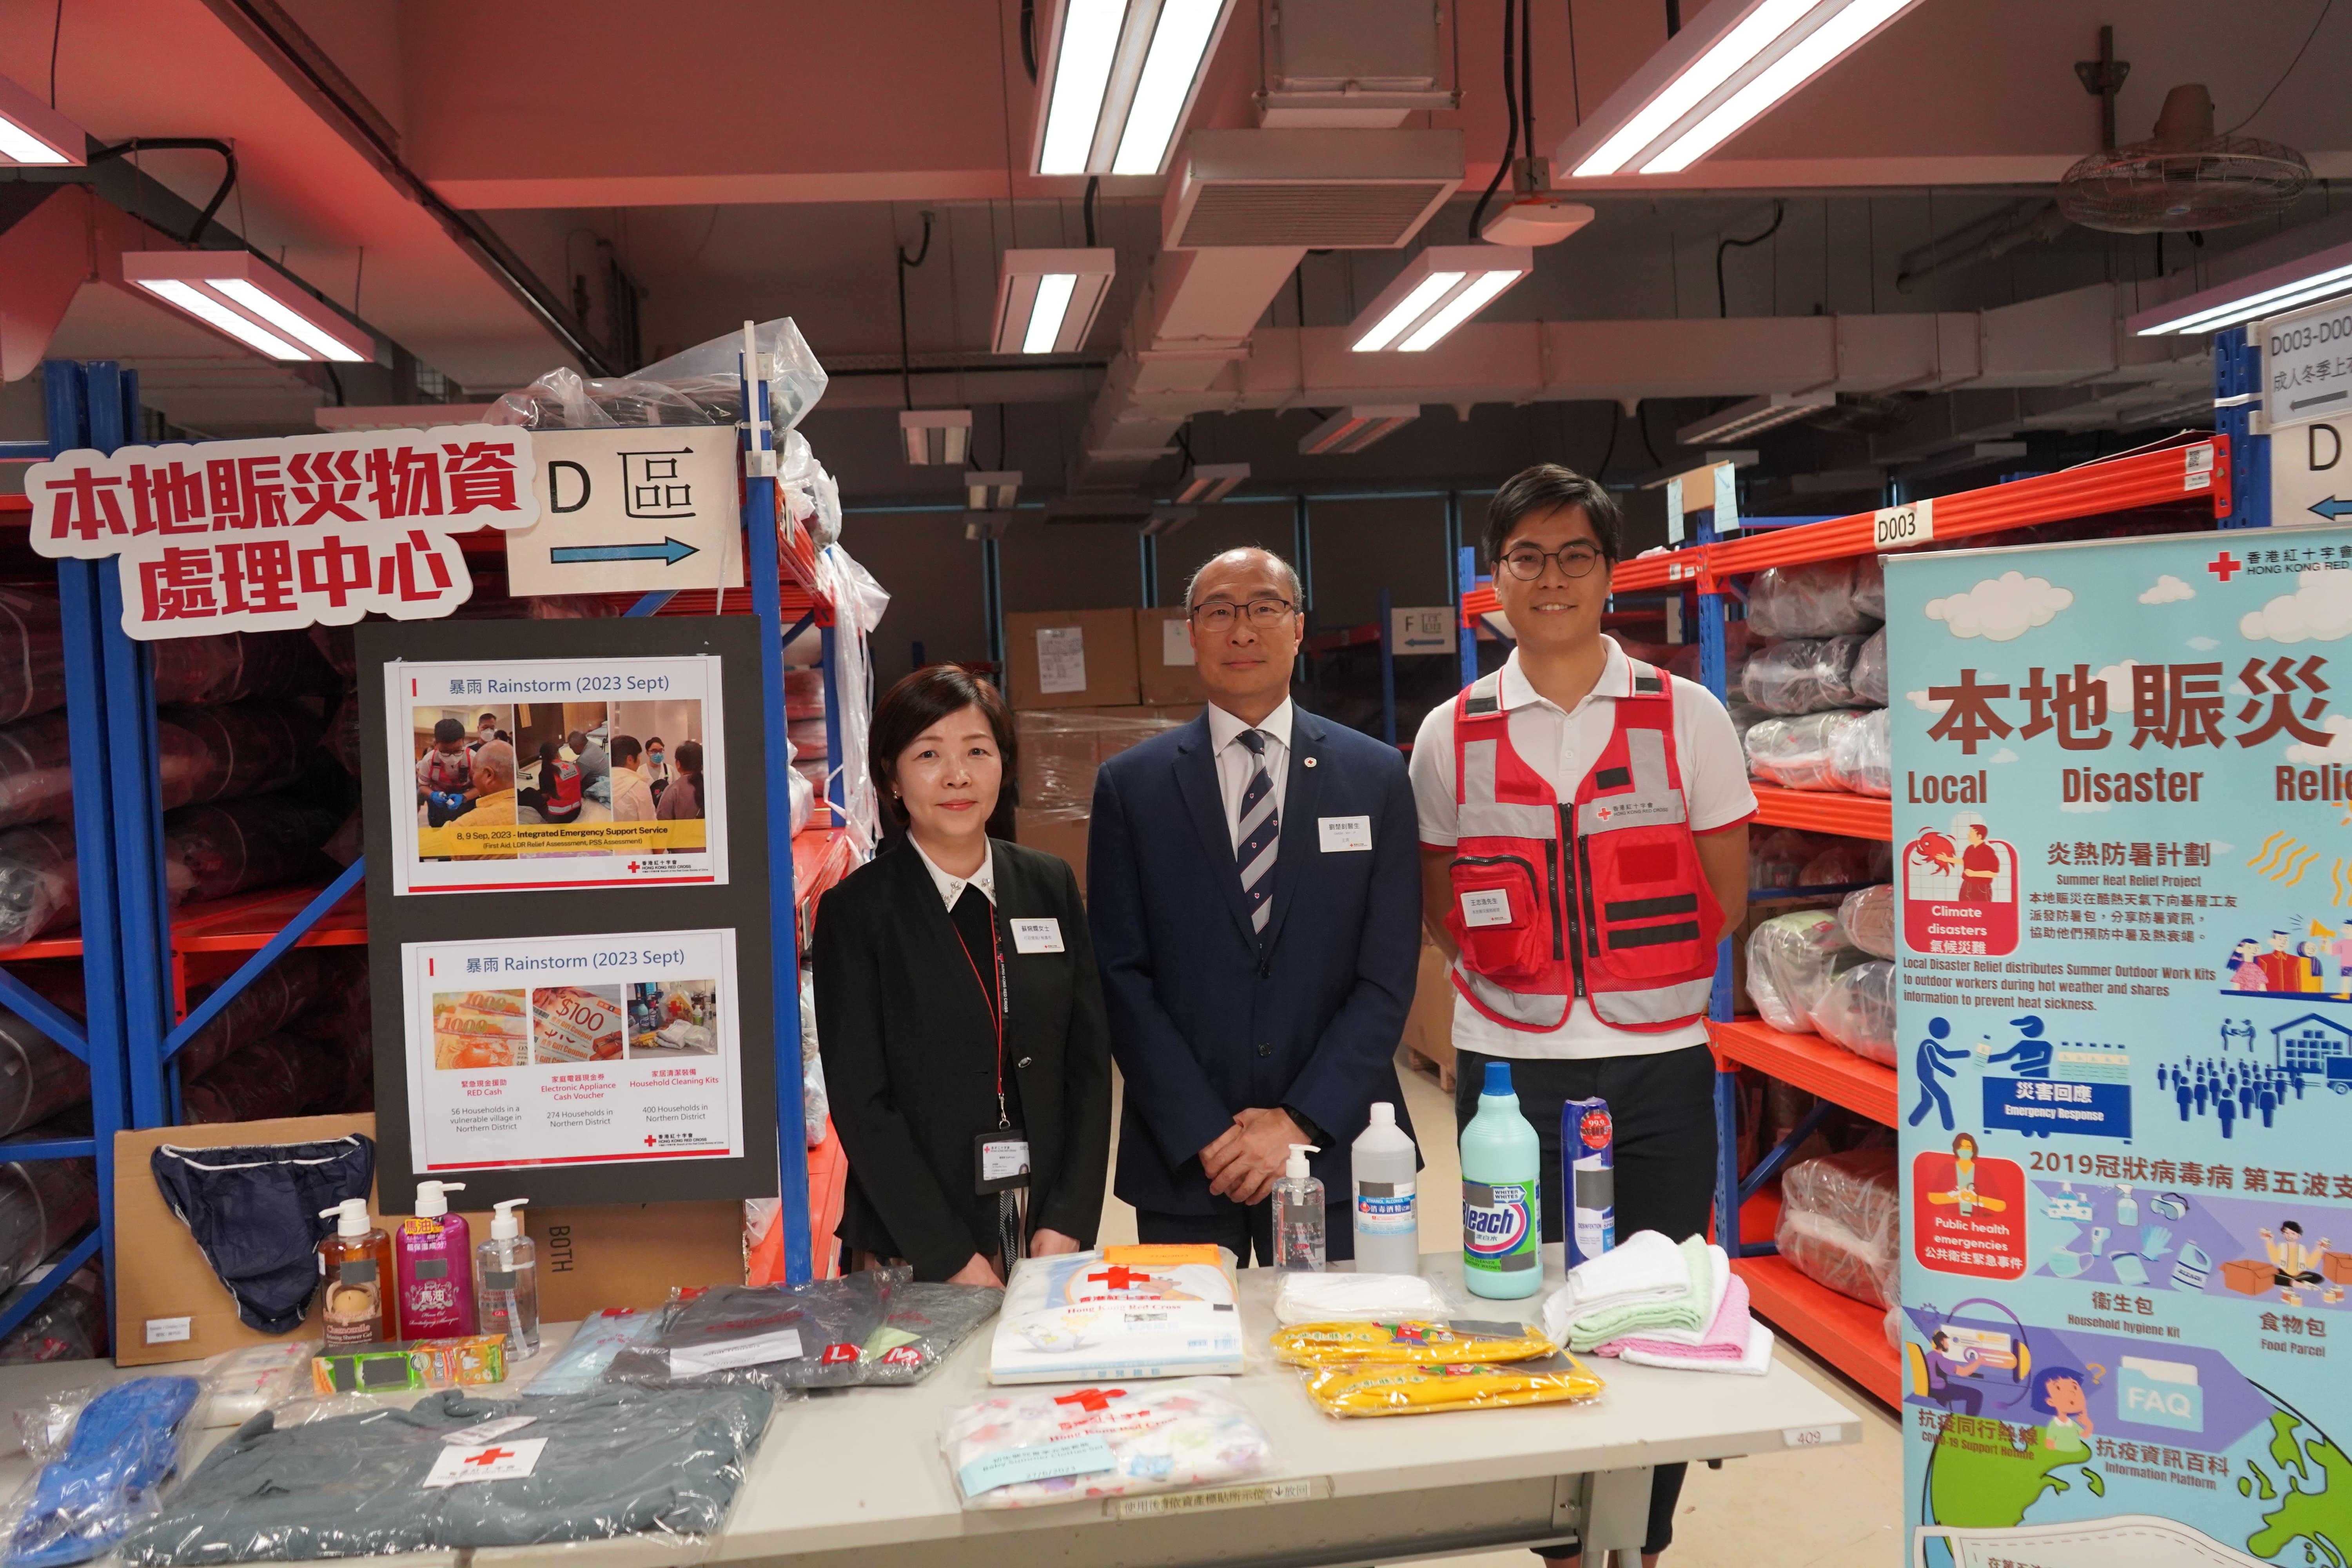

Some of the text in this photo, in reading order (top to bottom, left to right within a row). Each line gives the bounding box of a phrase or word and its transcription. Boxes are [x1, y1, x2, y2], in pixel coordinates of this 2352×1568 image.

[2309, 424, 2342, 471] D
[45, 441, 522, 541] 本地賑災物資
[548, 446, 697, 520] D 區
[1878, 512, 1916, 542] D003
[2247, 545, 2352, 564] 香港紅十字會
[140, 530, 453, 622] 處理中心
[2247, 561, 2350, 575] HONG KONG RED
[1406, 612, 1442, 634] F 區
[450, 675, 670, 694] 暴雨 Rainstorm (2023 Sept)
[1927, 655, 2336, 755] 本地賑災
[1908, 769, 1987, 804] Local
[2063, 766, 2205, 803] Disaster
[1613, 802, 1653, 811] 香港紅十字會
[517, 830, 559, 838] Integrated
[560, 828, 604, 838] Emergency
[606, 828, 637, 837] Support
[639, 826, 668, 835] Service
[2047, 841, 2211, 867] 炎熱防暑計劃
[2057, 874, 2201, 888] Summer Heat Relief Project
[1931, 905, 1982, 918] Climate
[1927, 923, 1987, 936] disasters
[1930, 940, 1987, 955] 氣候災難
[466, 949, 685, 973] 暴雨 Rainstorm (2023 Sept)
[1903, 957, 2216, 981] Local Disaster Relief distributes Summer Outdoor Work Kits
[1904, 974, 2170, 996] to outdoor workers during hot weather and shares
[1904, 991, 2097, 1011] information to prevent heat sickness.
[555, 998, 604, 1031] $100
[541, 1082, 616, 1093] Electronic Appliance
[630, 1079, 670, 1087] Household
[671, 1077, 704, 1086] Cleaning
[2015, 1081, 2093, 1103] 災害回應
[462, 1106, 505, 1114] Households
[562, 1109, 605, 1118] Households
[658, 1104, 700, 1113] Households
[2004, 1103, 2105, 1122] Emergency Response
[450, 1116, 488, 1124] vulnerable
[490, 1114, 513, 1123] village
[2029, 1151, 2234, 1191] 2019冠狀病毒病
[406, 1220, 431, 1233] 馬油
[1463, 1204, 1514, 1234] Bleach
[1935, 1217, 2010, 1236] Public health
[549, 1225, 573, 1272] BOTH
[1933, 1235, 2009, 1252] emergencies
[1067, 1306, 1095, 1314] Hong
[2067, 1314, 2181, 1339] Household hygiene Kit
[2259, 1311, 2327, 1338] 食物包
[831, 1347, 850, 1360] L
[2260, 1338, 2325, 1358] Food Parcel
[2127, 1386, 2193, 1420] FAQ
[1798, 1430, 1821, 1445] 409
[1922, 1431, 1959, 1448] COVID-19
[1961, 1439, 1998, 1455] Support
[2096, 1437, 2230, 1478] 抗疫資訊百科
[2105, 1461, 2217, 1491] Information Platform
